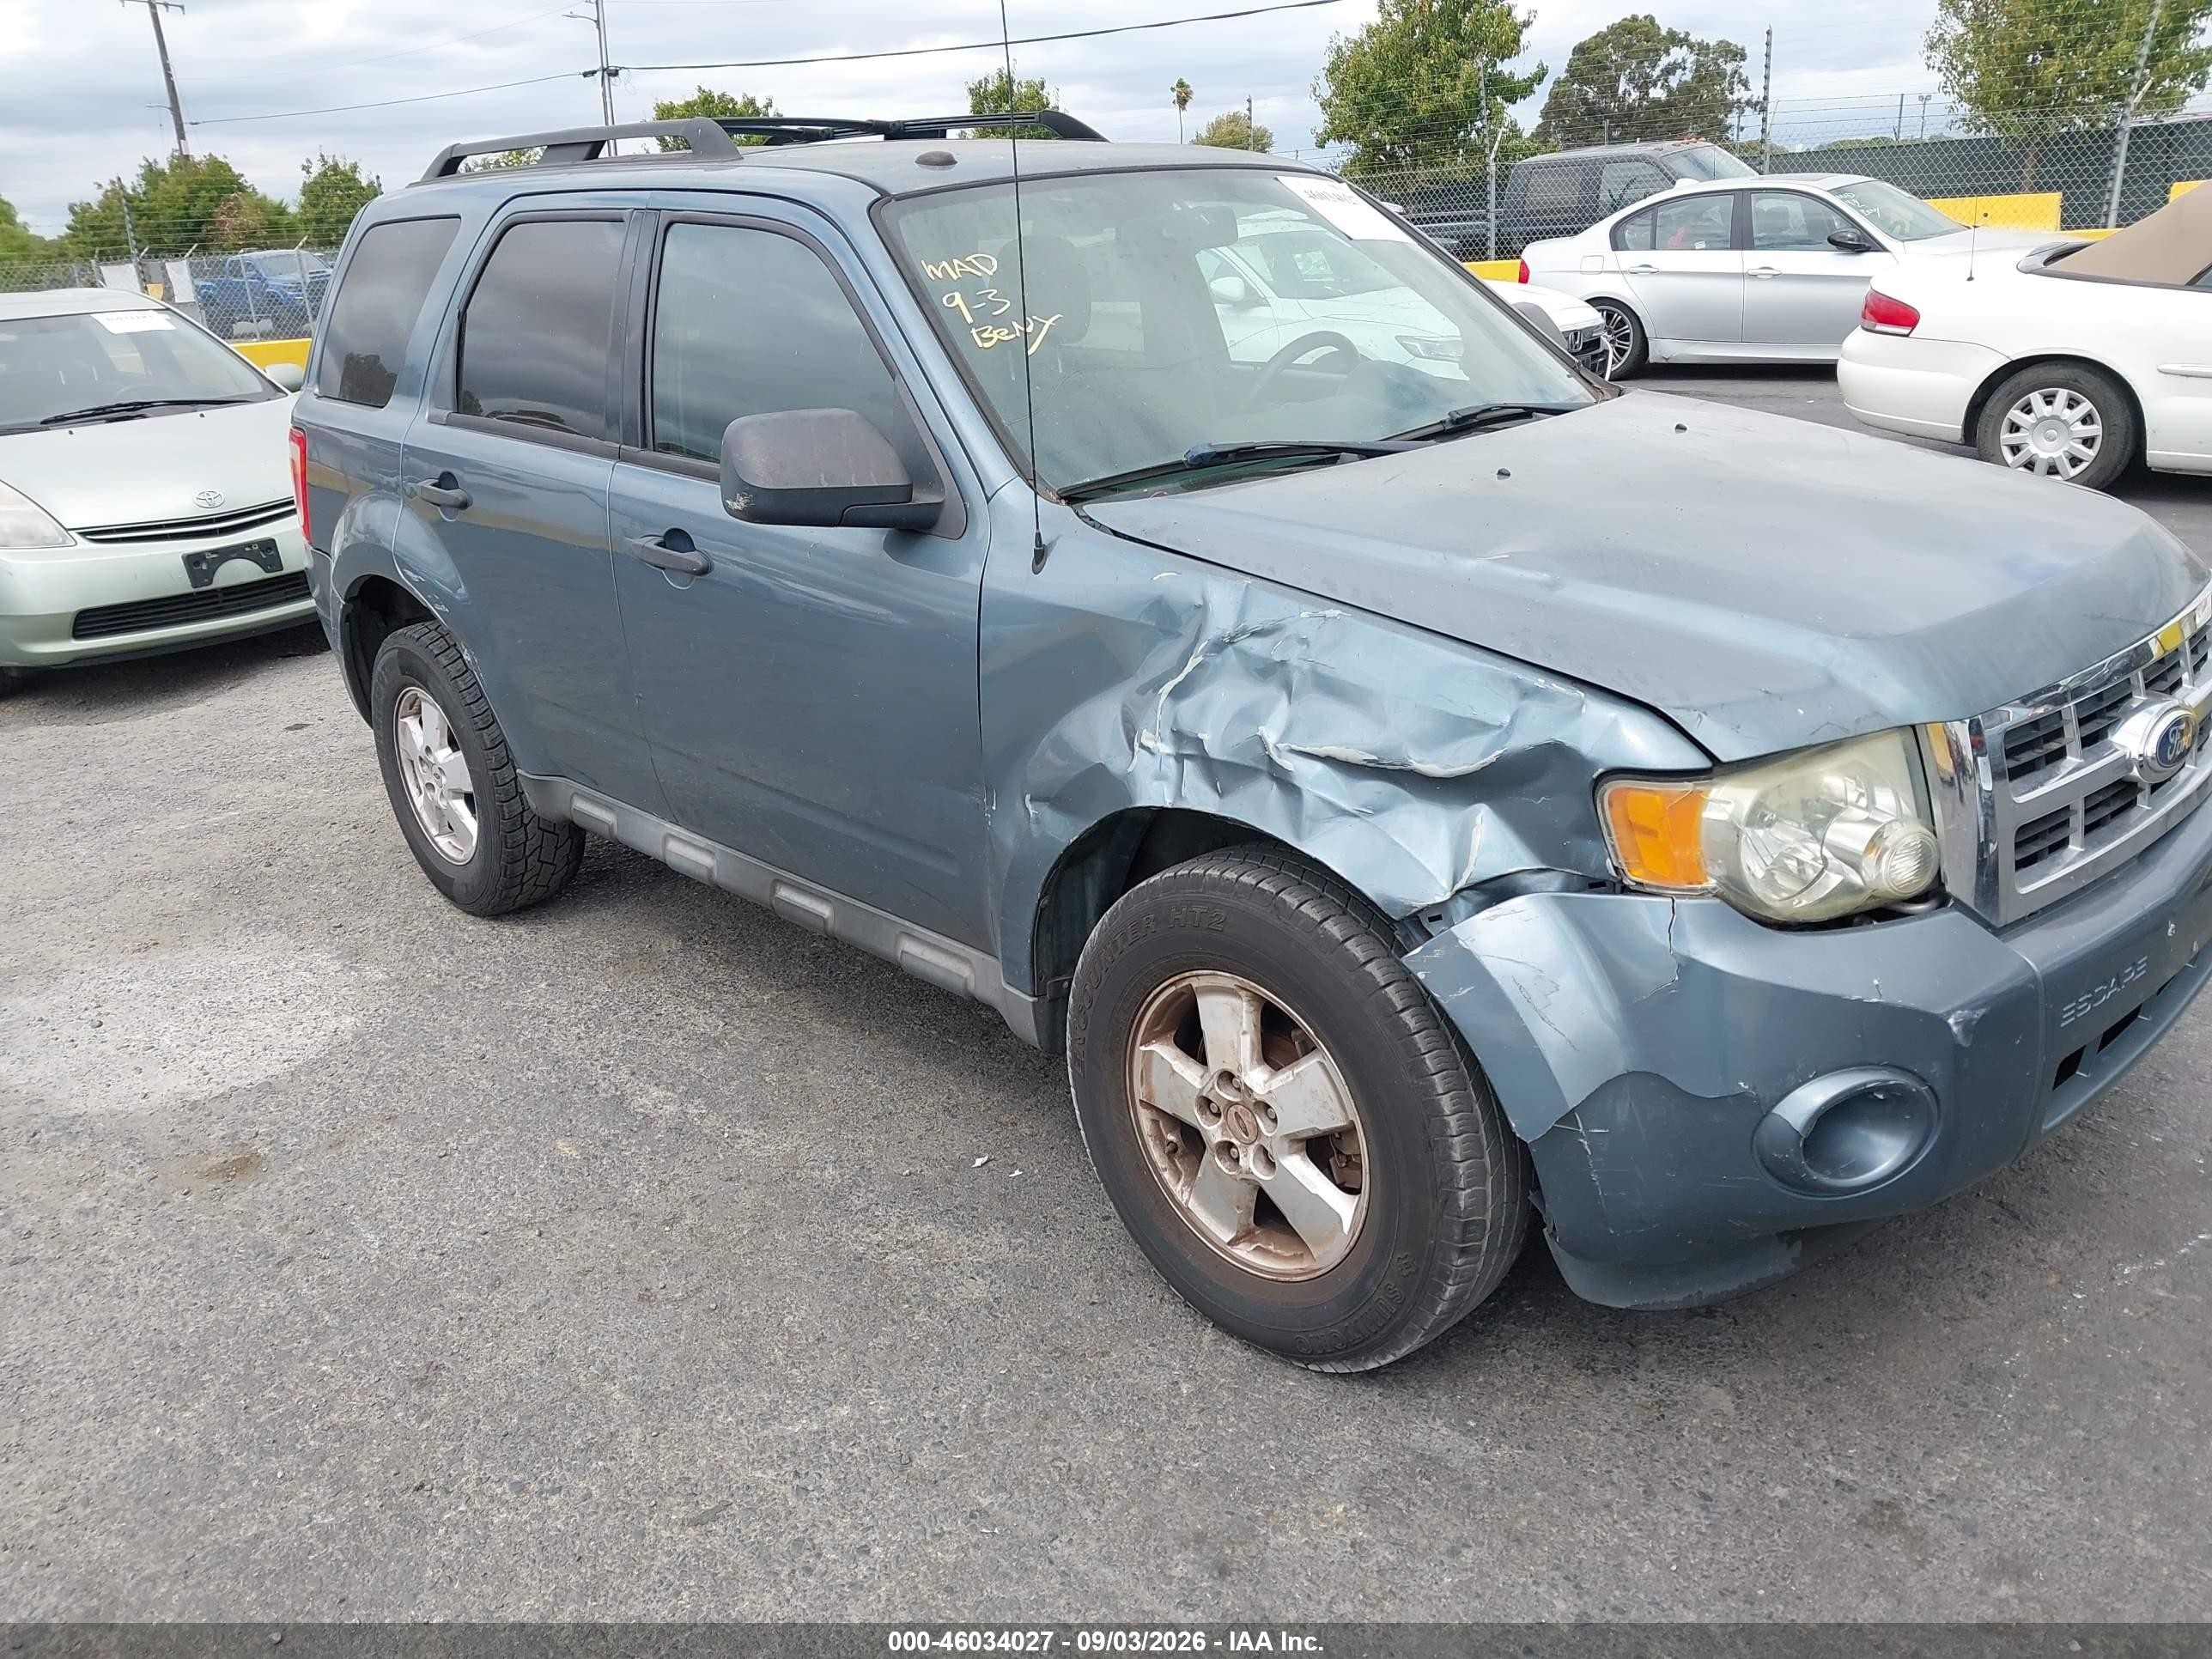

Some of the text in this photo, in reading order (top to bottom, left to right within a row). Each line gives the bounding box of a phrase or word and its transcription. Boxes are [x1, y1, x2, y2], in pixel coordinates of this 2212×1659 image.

[921, 253, 998, 281] MAD
[942, 289, 1011, 325] 9-3
[1168, 904, 1227, 932] HT2
[2060, 955, 2148, 1028] ESCAPE
